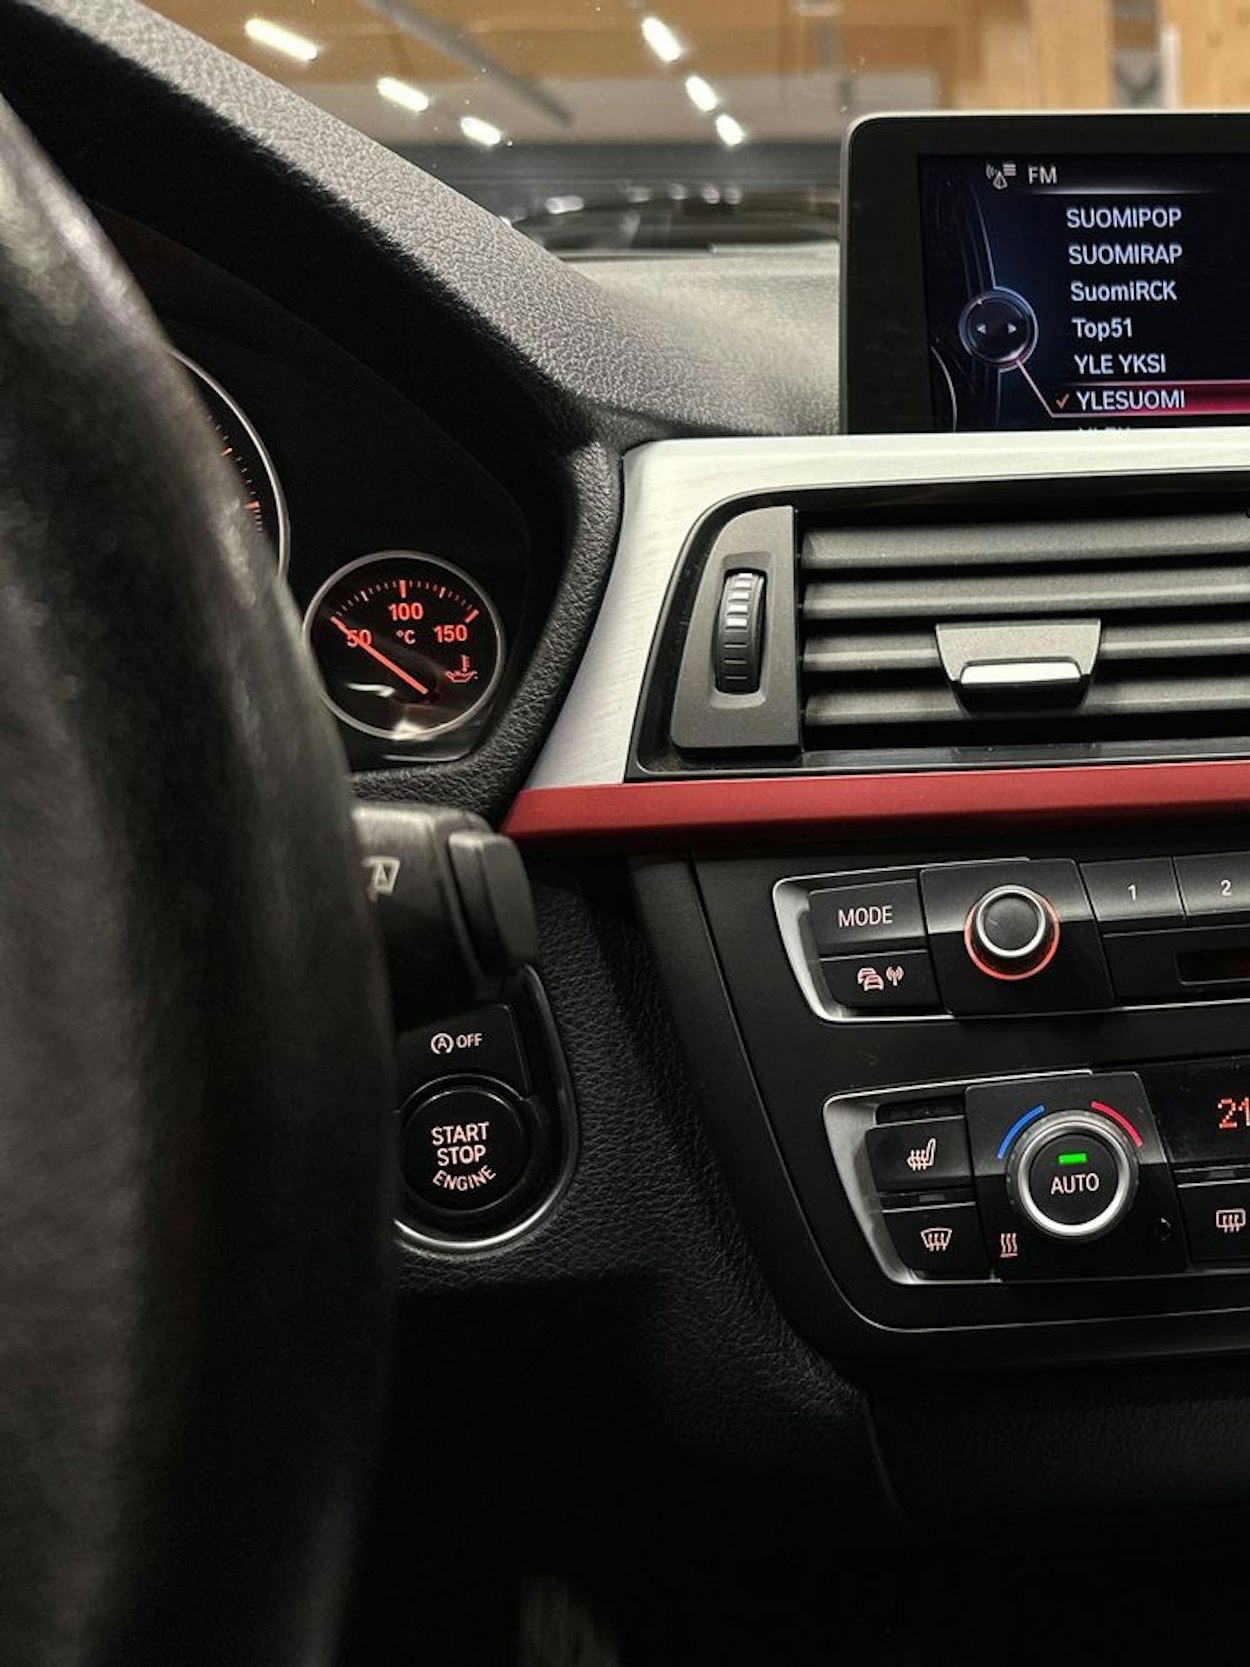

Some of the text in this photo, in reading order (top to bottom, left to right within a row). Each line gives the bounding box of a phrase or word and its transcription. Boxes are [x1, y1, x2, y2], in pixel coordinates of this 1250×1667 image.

[1028, 166, 1057, 184] FM
[1066, 207, 1182, 229] SUOMIPOP
[1068, 243, 1183, 265] SUOMIRAP
[1070, 280, 1178, 301] SuomiRCK
[1071, 317, 1133, 341] Top51
[1074, 353, 1166, 375] YLE YKSI
[1076, 389, 1185, 411] YLESUOMI
[388, 602, 424, 622] 100
[346, 629, 372, 648] 50
[433, 624, 468, 643] 150
[1128, 884, 1138, 900] 1
[1220, 880, 1233, 896] 2
[837, 904, 894, 927] MODE
[455, 1032, 484, 1049] OFF
[431, 1121, 490, 1146] START
[436, 1144, 486, 1165] STOP
[432, 1165, 496, 1191] ENGINE
[1050, 1172, 1100, 1195] AUTO
